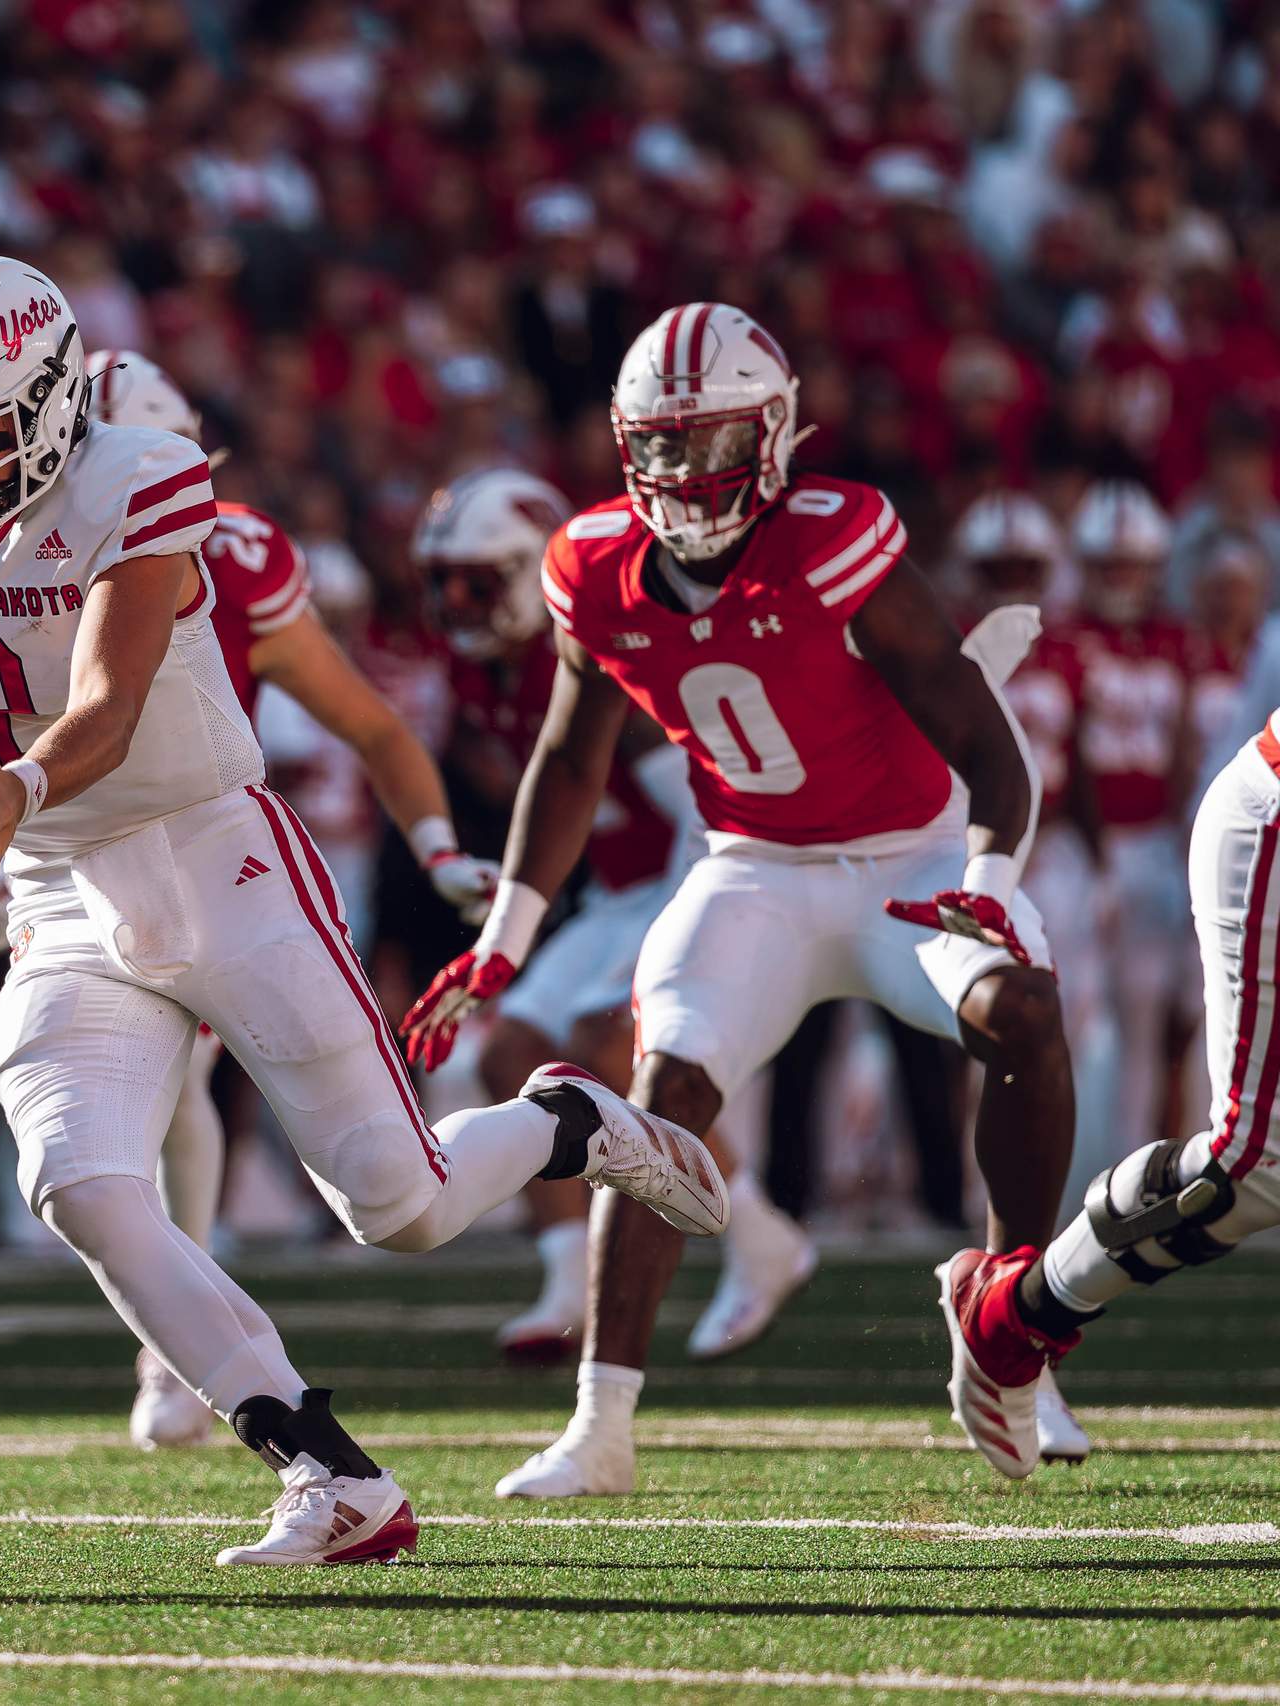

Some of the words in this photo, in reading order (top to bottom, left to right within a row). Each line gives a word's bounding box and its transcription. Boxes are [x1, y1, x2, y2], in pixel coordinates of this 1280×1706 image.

[787, 489, 845, 517] 0
[35, 549, 72, 560] adidas
[678, 662, 808, 795] 0
